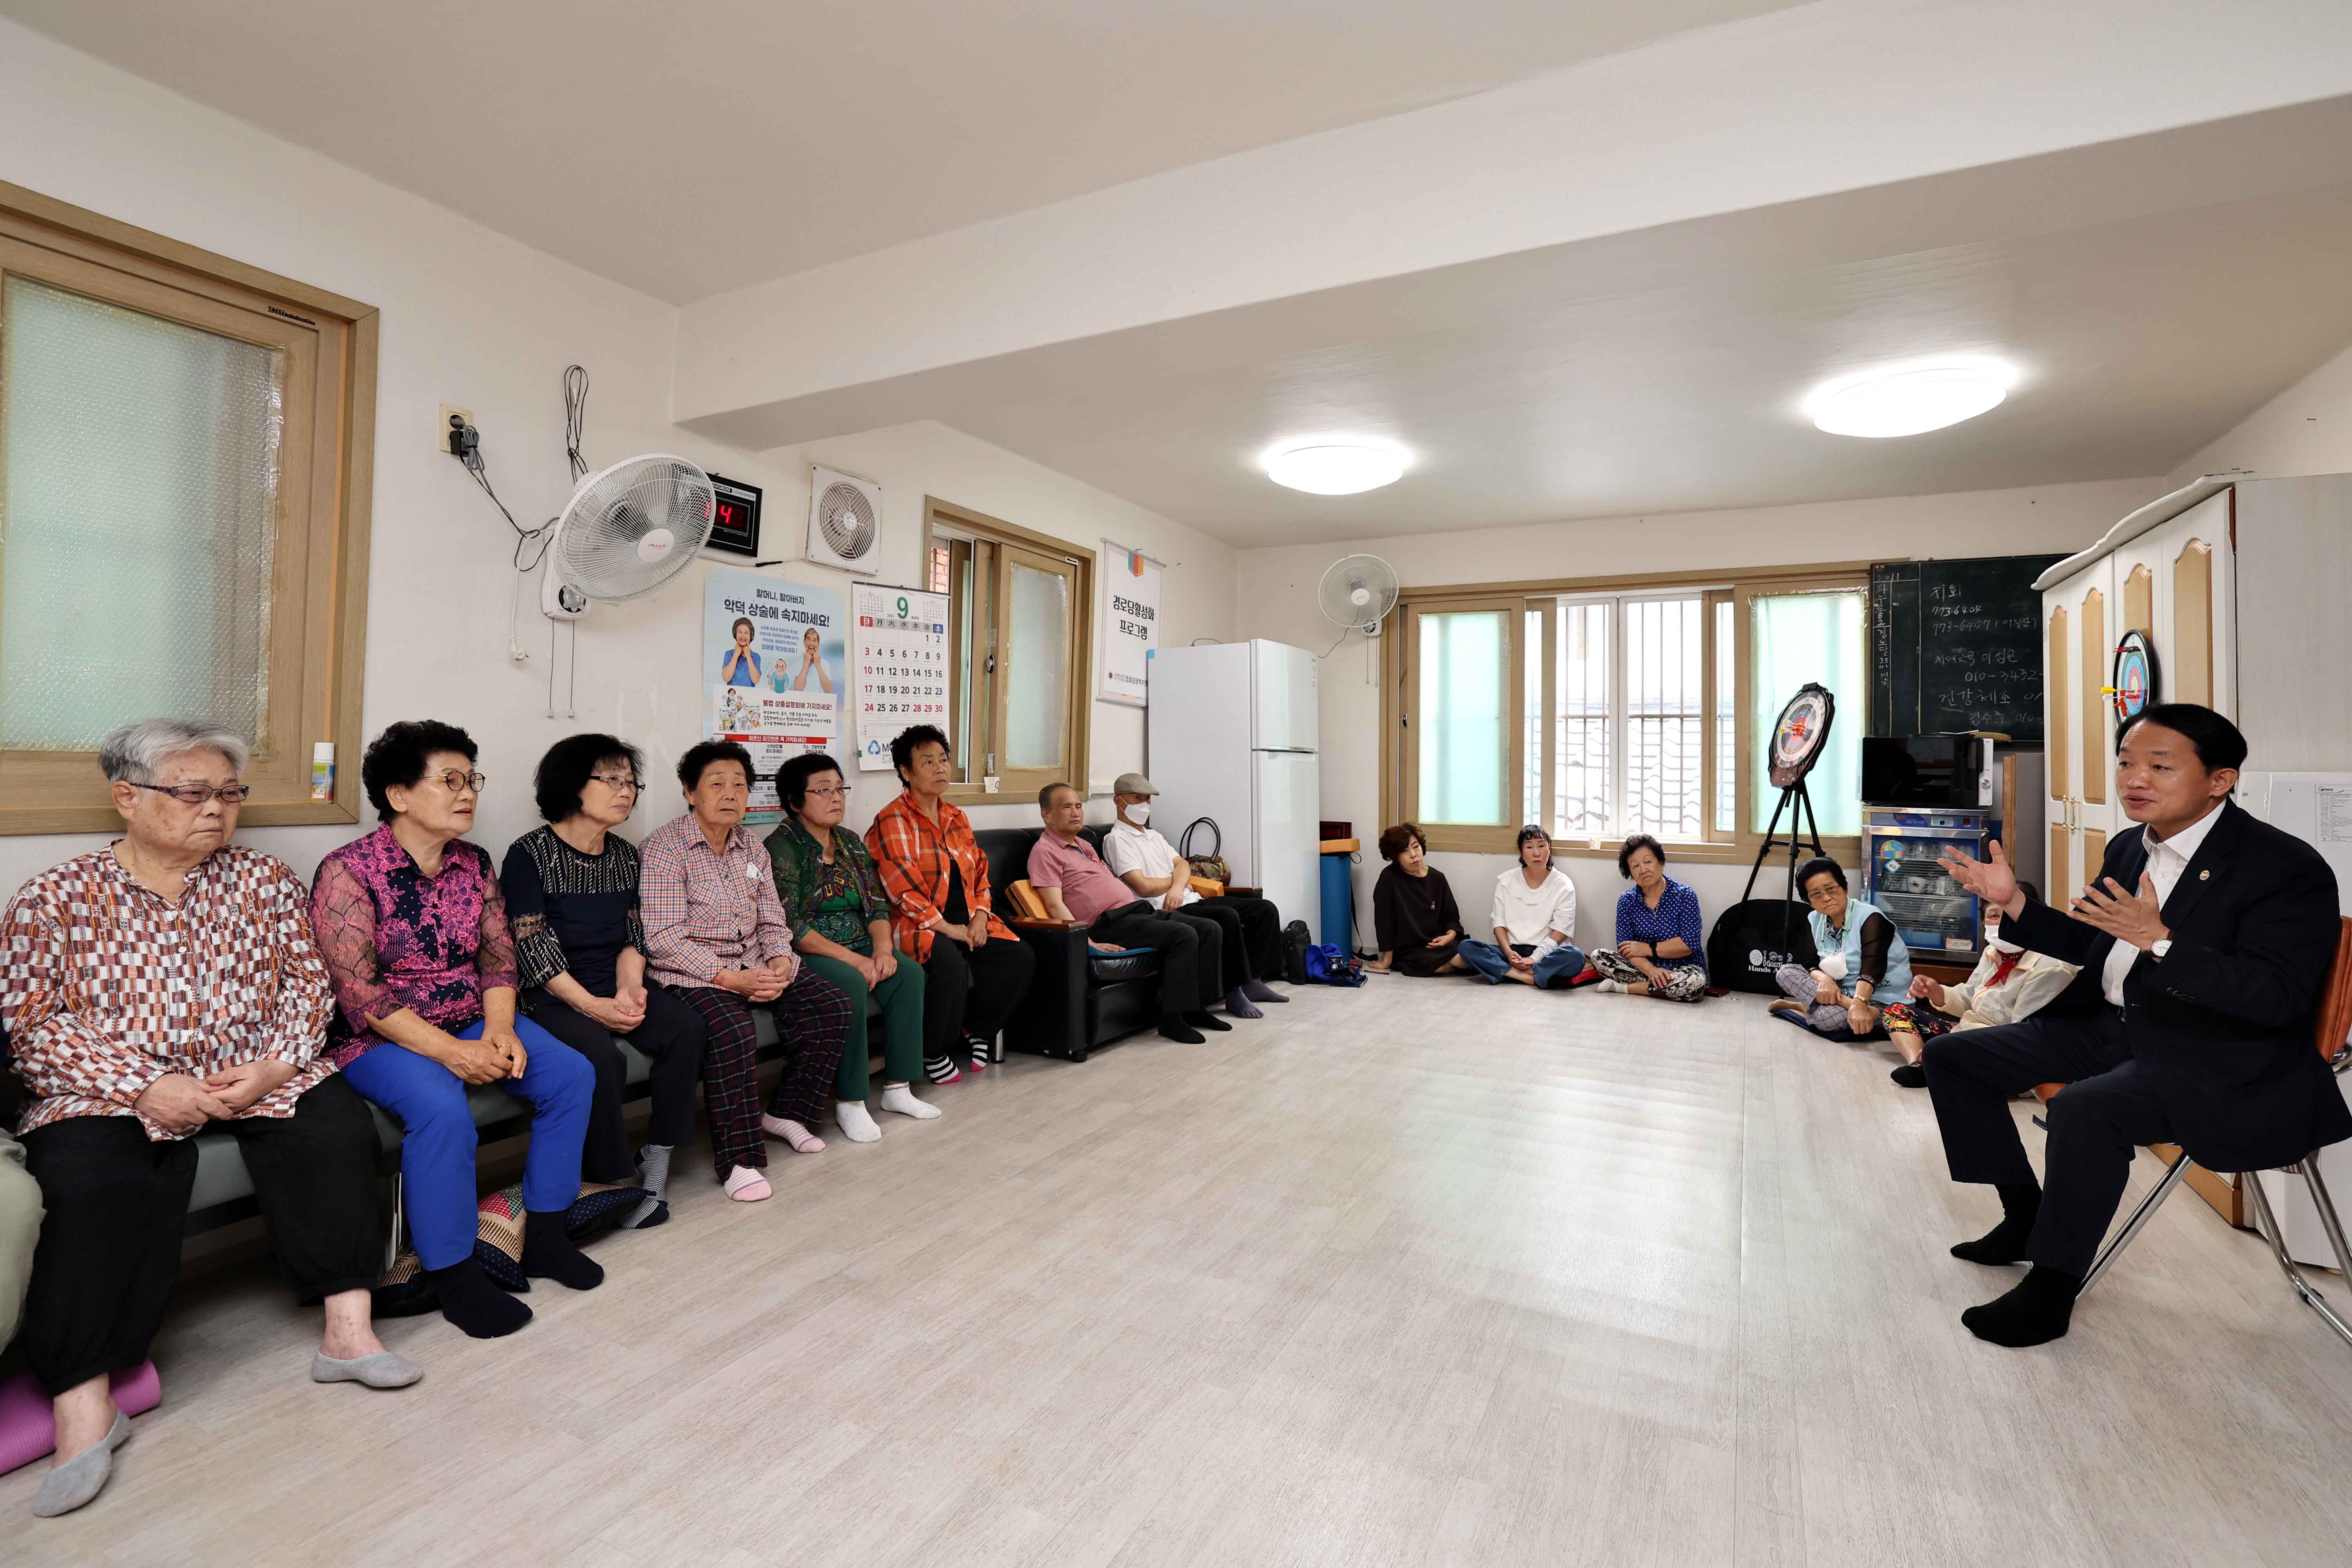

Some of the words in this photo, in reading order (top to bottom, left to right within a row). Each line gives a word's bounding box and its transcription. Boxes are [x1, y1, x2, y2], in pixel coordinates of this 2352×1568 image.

[720, 505, 733, 524] 4
[756, 588, 778, 601] 할머니,
[779, 593, 804, 605] 할아버지
[724, 599, 745, 615] 악덕
[748, 603, 779, 619] 상술에
[781, 608, 829, 627] 속지마세요!
[897, 597, 908, 619] 9
[1113, 595, 1154, 621] 경로당활성화
[1119, 619, 1147, 641] 프로그램
[877, 667, 884, 675] 11
[865, 685, 873, 693] 17
[775, 701, 805, 709] 상품설명회에
[865, 703, 874, 711] 24
[877, 704, 886, 712] 25
